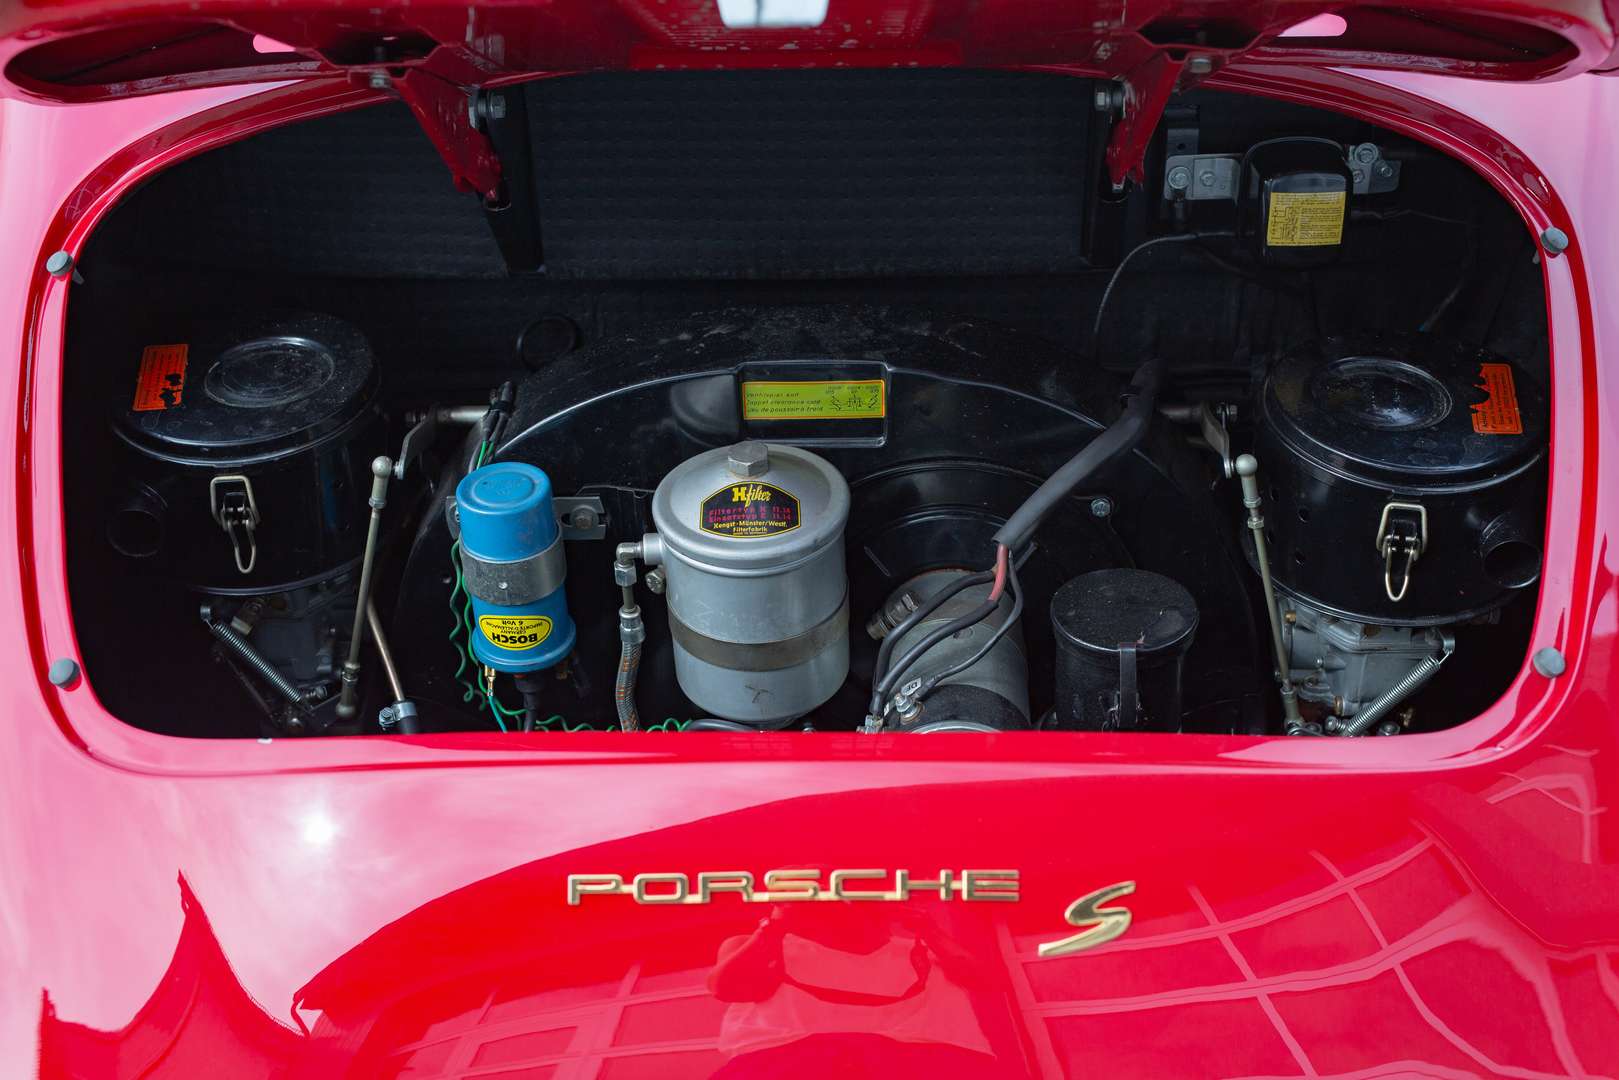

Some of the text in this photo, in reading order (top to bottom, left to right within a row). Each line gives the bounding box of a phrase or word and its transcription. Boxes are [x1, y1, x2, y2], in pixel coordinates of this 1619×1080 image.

[491, 632, 538, 644] BOSCH
[567, 869, 1019, 905] PORSCHE
[1038, 880, 1136, 956] S
